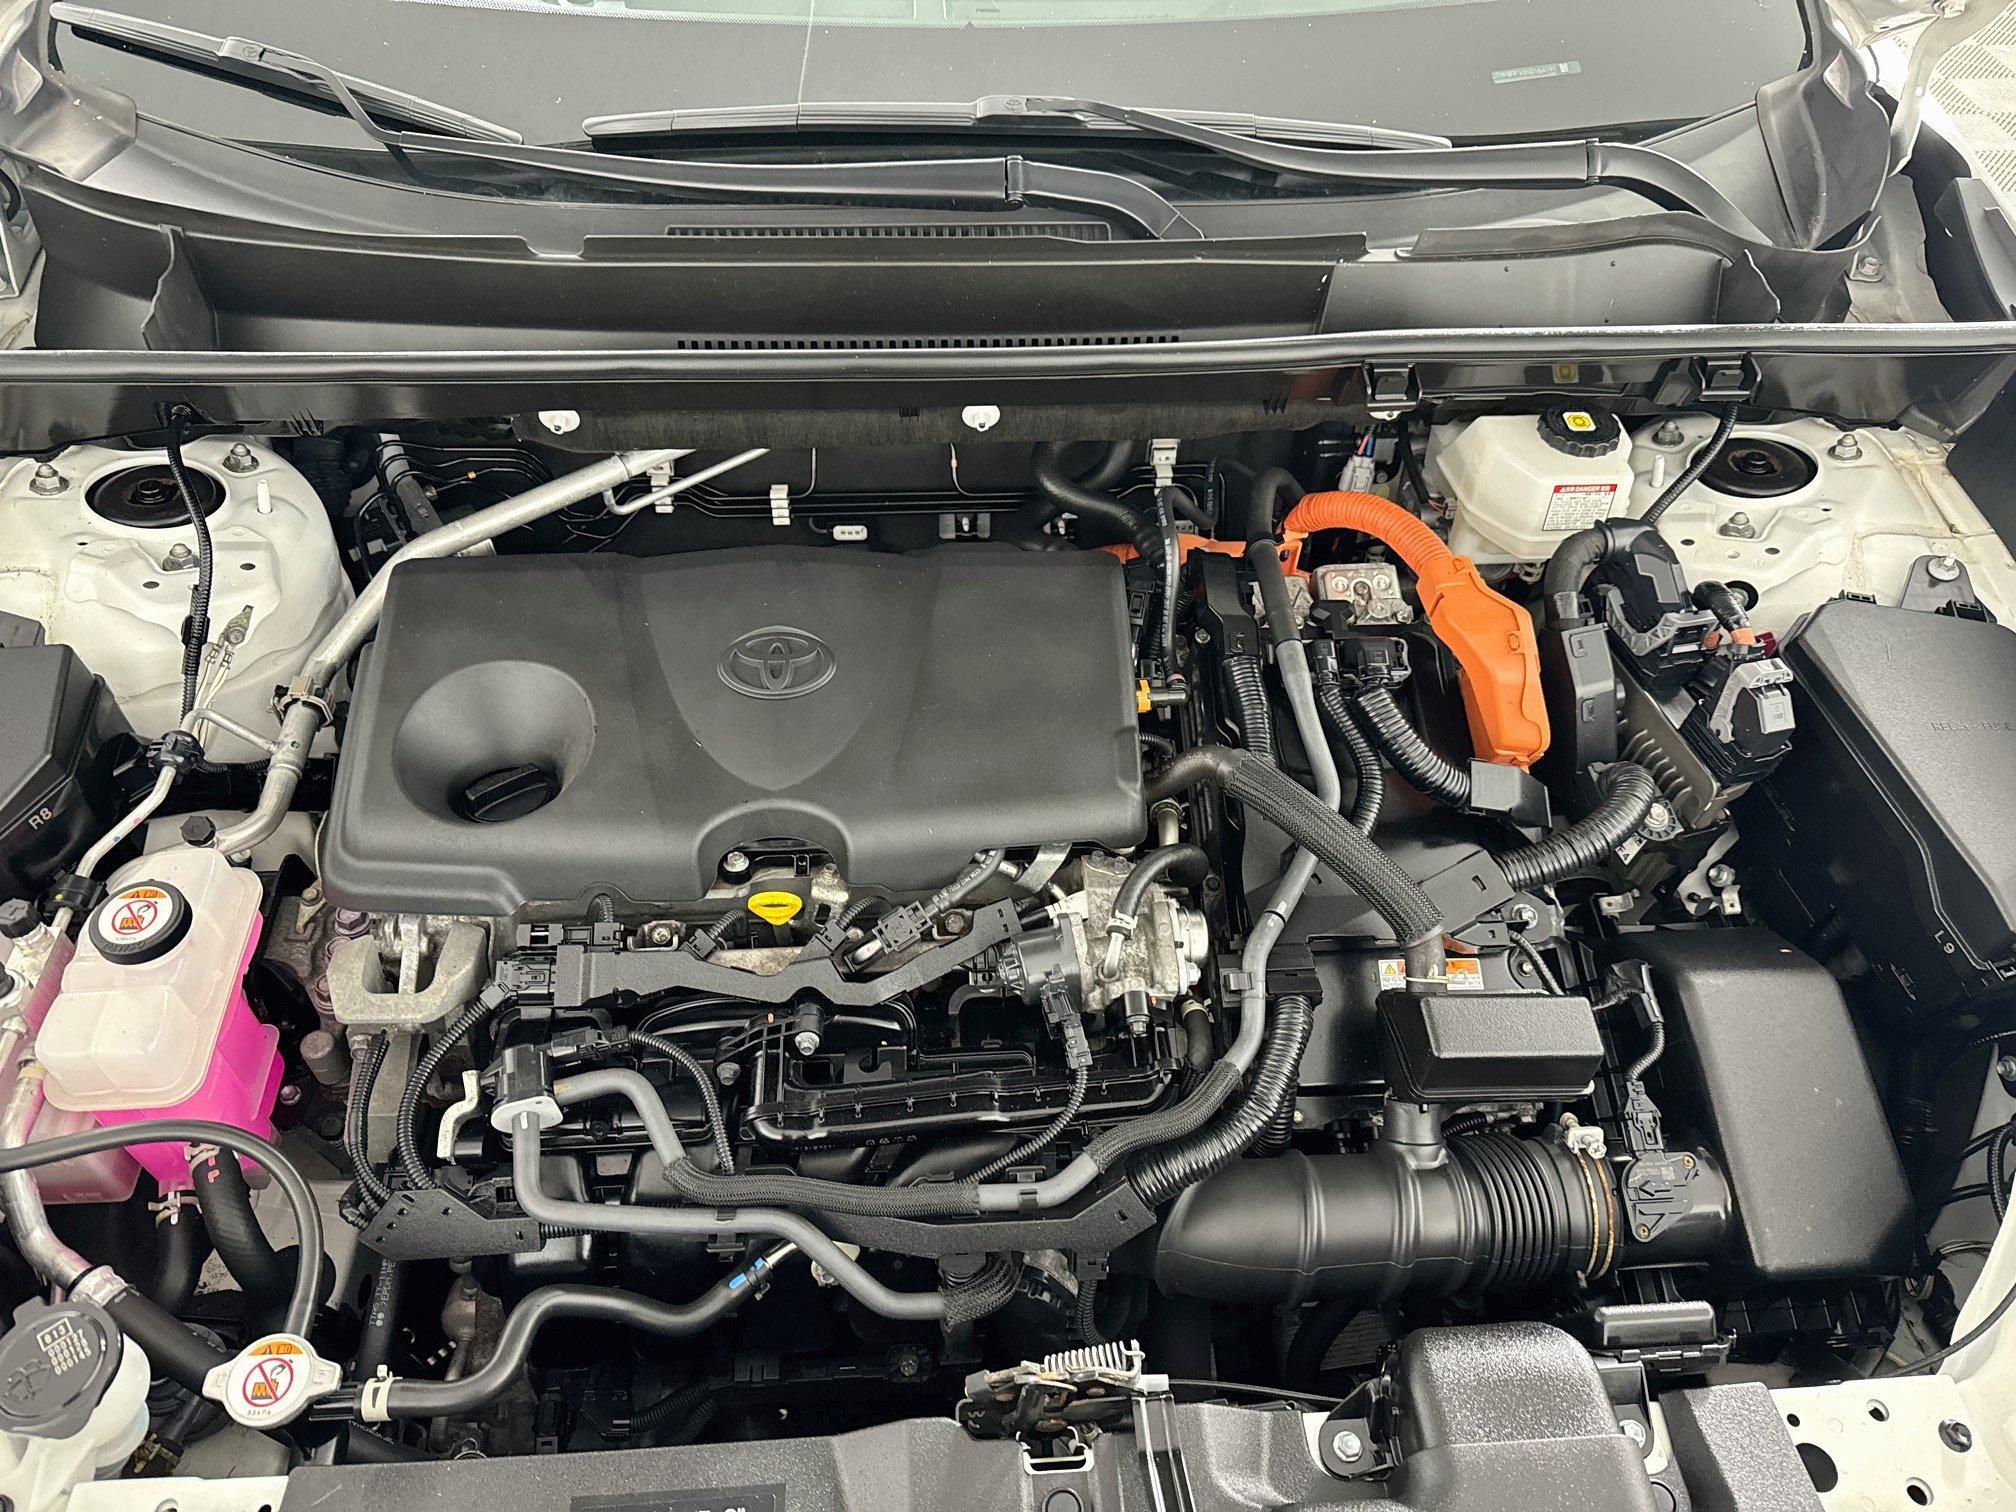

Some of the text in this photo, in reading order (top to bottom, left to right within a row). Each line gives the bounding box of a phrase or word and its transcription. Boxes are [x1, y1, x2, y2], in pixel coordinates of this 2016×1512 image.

[1930, 721, 1969, 732] RELAY
[28, 807, 53, 830] R8
[1617, 844, 1630, 861] F4
[1934, 929, 1955, 954] L9
[43, 1324, 66, 1344] 013
